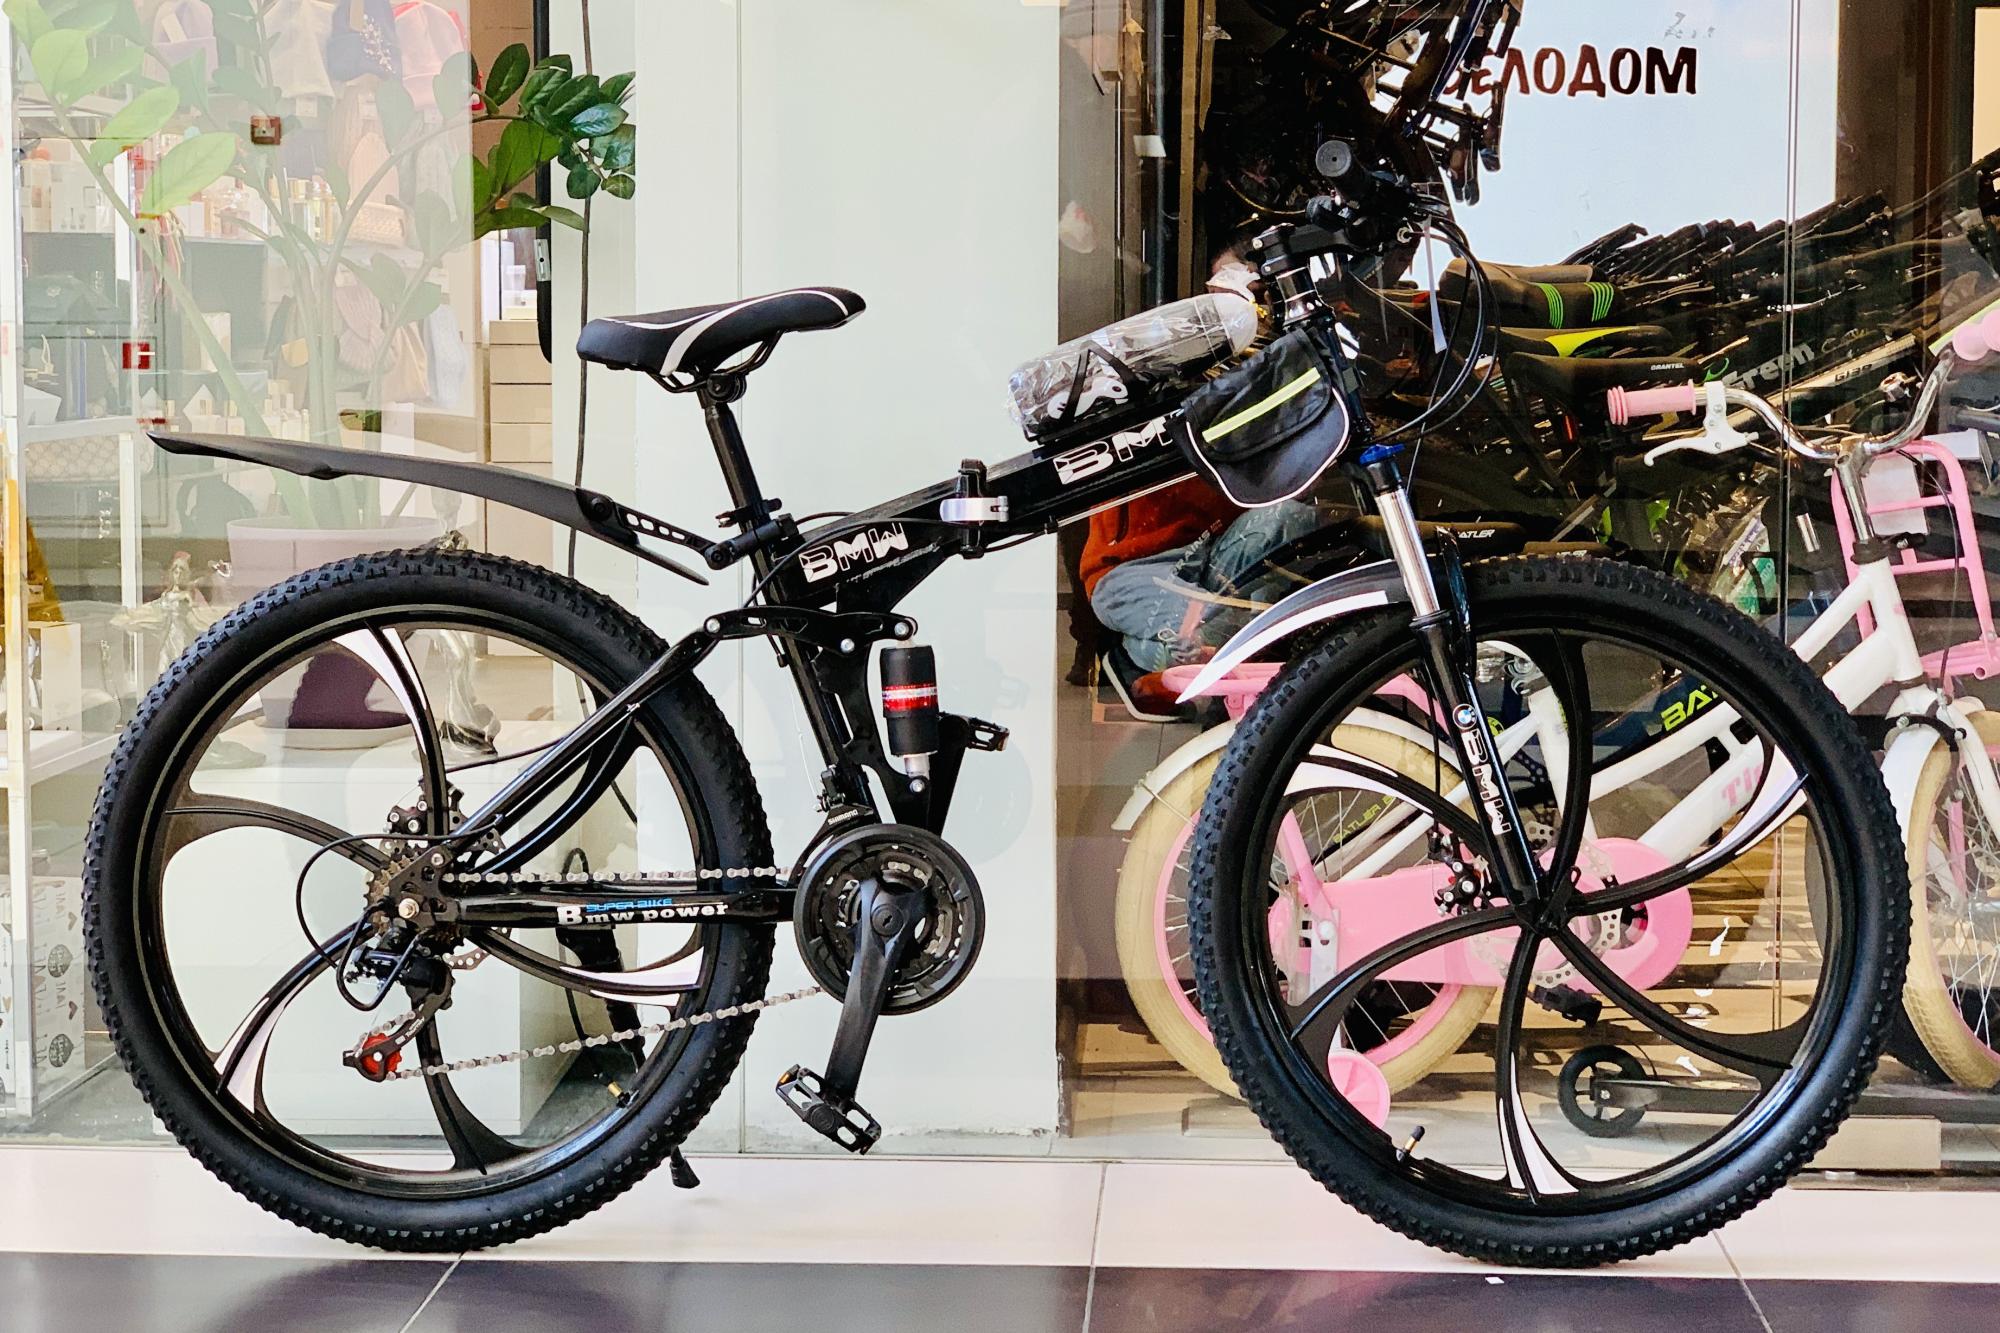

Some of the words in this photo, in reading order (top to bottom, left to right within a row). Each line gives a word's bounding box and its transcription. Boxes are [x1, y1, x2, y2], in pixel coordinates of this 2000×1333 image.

[1053, 408, 1185, 484] BM
[1458, 529, 1496, 539] ATLER
[799, 522, 909, 583] BMW
[1461, 728, 1512, 836] BMW
[827, 809, 859, 825] SHIMANO
[586, 901, 635, 912] SUPER
[637, 898, 673, 908] BIKE
[642, 902, 729, 922] power
